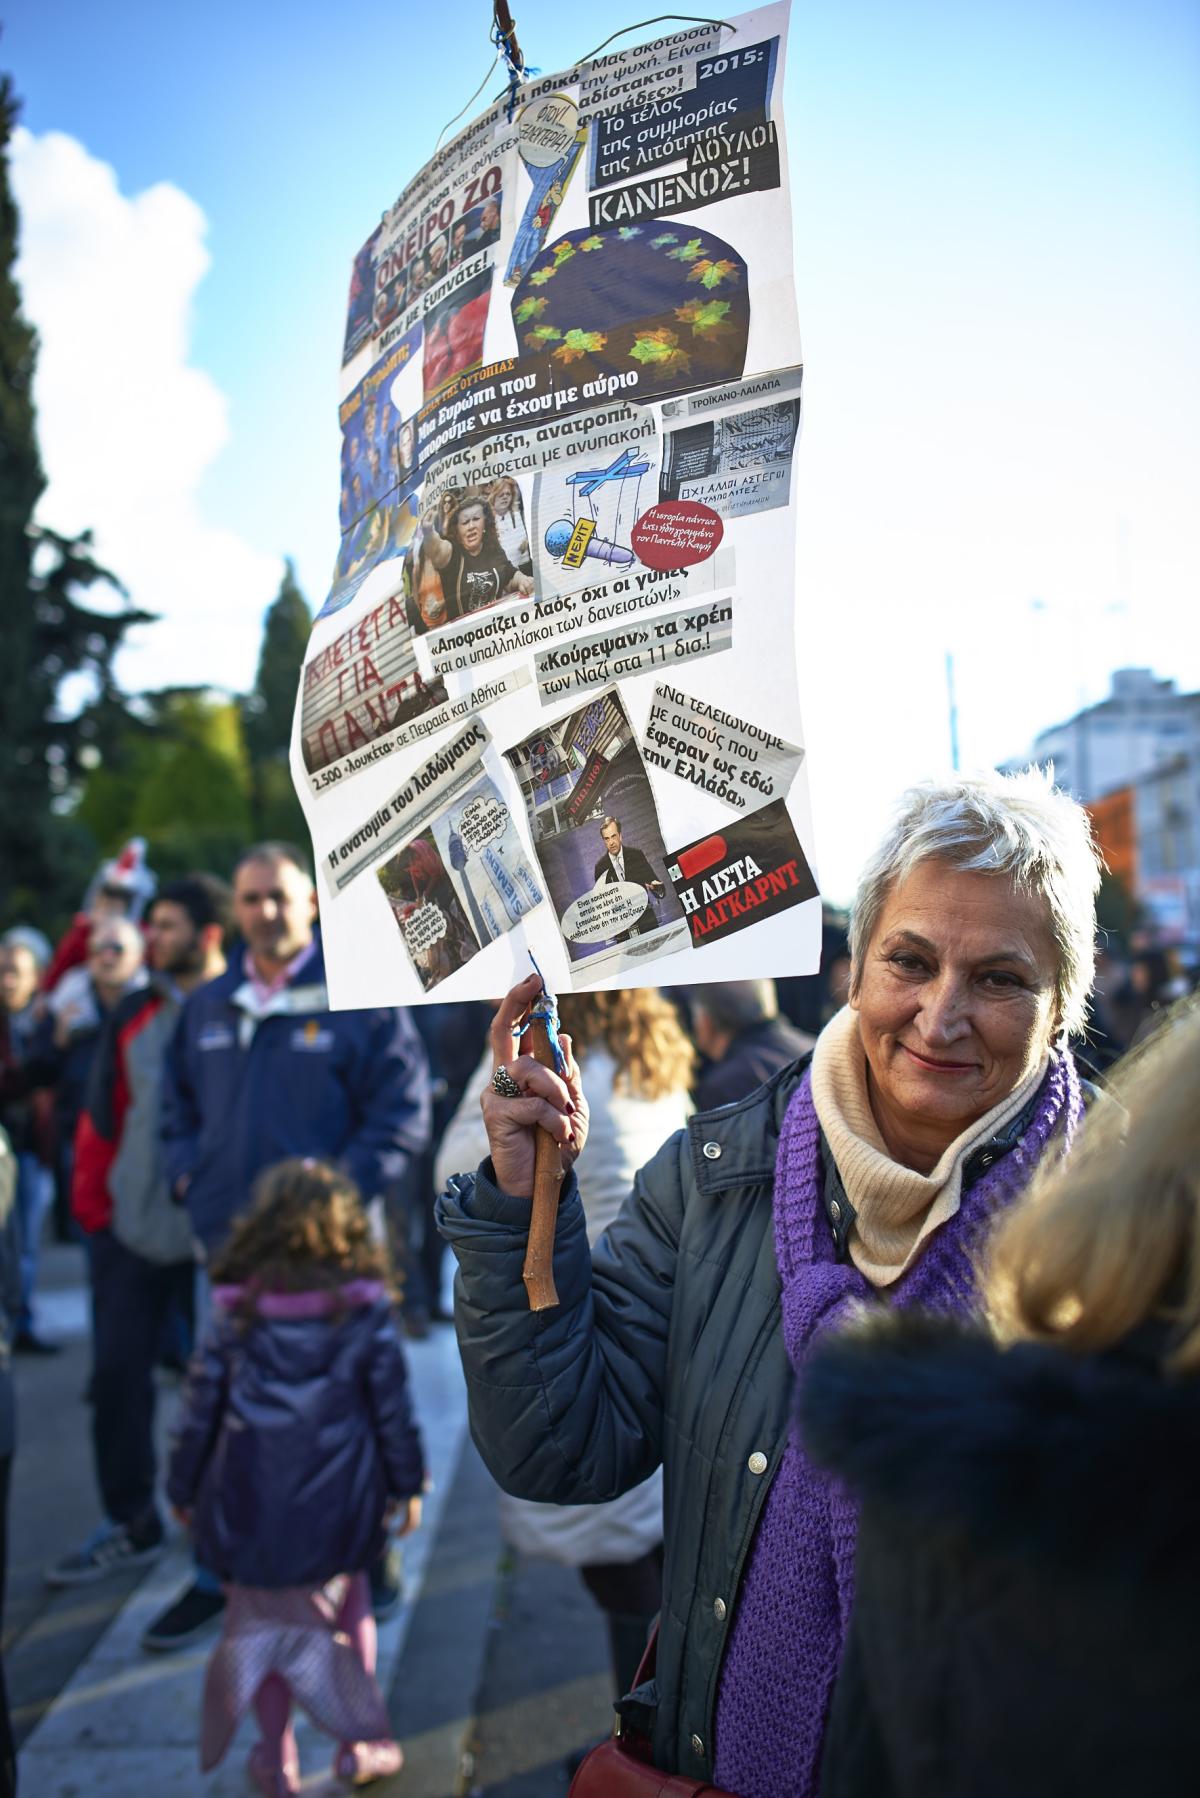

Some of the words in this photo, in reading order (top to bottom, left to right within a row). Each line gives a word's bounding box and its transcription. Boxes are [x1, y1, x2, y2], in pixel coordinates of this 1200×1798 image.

[580, 73, 607, 92] την
[613, 56, 662, 81] ψυχή.
[668, 41, 711, 62] Είναι
[592, 52, 627, 72] Μας
[633, 25, 721, 58] σκότωσαν
[700, 50, 764, 80] 2015:
[531, 70, 580, 99] ηθικό
[579, 64, 683, 109] αδίστακτοι
[602, 136, 632, 156] της
[637, 98, 738, 142] συμμορίας
[603, 118, 625, 135] Το
[631, 96, 683, 125] τέλος
[692, 123, 774, 166] ΔΟΥΛΟΙ
[600, 156, 630, 177] της
[636, 122, 728, 166] λιτότητας
[594, 157, 751, 226] ΚΑΝΕΝΟΣ!
[377, 198, 455, 289] ΟΝΕΙΡΟ
[463, 166, 502, 215] ΖΩ
[424, 250, 488, 313] ξυπνάτε!
[438, 385, 496, 428] Ευρώπη
[500, 373, 536, 396] που
[479, 408, 502, 426] να
[582, 370, 639, 398] αύριο
[691, 379, 781, 409] ΤΡΟΪΚΑΝΟ-ΛΑΙΛΑΠΑ
[424, 448, 477, 488] Αγώνας,
[482, 431, 531, 462] ρήξη,
[536, 400, 639, 442] ανατροπή,
[462, 454, 538, 487] γράφεται
[542, 451, 562, 468] με
[566, 418, 657, 456] ανυπακοή!
[431, 614, 517, 656] «Αποφασίζει
[520, 612, 530, 625] ο
[533, 595, 577, 620] λαός,
[581, 585, 609, 605] όχι
[613, 580, 631, 594] οι
[433, 659, 453, 675] και
[455, 655, 467, 669] οι
[469, 626, 554, 665] υπαλληλίσκοι
[556, 614, 584, 634] των
[588, 583, 682, 623] δανειστών!»
[540, 630, 649, 674] «Κούρεψαν»
[654, 618, 678, 640] τα
[683, 603, 733, 632] χρέη
[337, 656, 384, 703] ΓΙΑ
[543, 676, 571, 696] των
[574, 660, 610, 686] Ναζί
[614, 653, 642, 674] στα
[648, 644, 666, 665] 11
[674, 631, 712, 657] δισ.!
[655, 684, 685, 706] «Να
[312, 767, 342, 791] 2.500
[344, 742, 395, 774] «λουκέτα»
[396, 734, 410, 747] σε
[409, 708, 451, 740] Πειραιά
[451, 702, 469, 719] και
[471, 680, 507, 708] Αθήνα
[646, 721, 710, 764] έφεραν
[713, 757, 737, 781] ως
[740, 770, 774, 796] εδώ
[650, 704, 669, 722] με
[672, 714, 726, 751] αυτούς
[728, 739, 759, 763] που
[328, 851, 340, 869] Η
[340, 808, 392, 860] ανατομία
[391, 789, 414, 814] του
[416, 724, 486, 795] λαδώματος
[643, 746, 672, 770] την
[674, 758, 746, 808] Ελλάδα»
[485, 847, 523, 916] SIEMENS
[678, 887, 701, 915] Η
[701, 855, 763, 904] ΛΙΣΤΑ
[692, 859, 800, 938] ΛΑΓΚΑΡΝΤ
